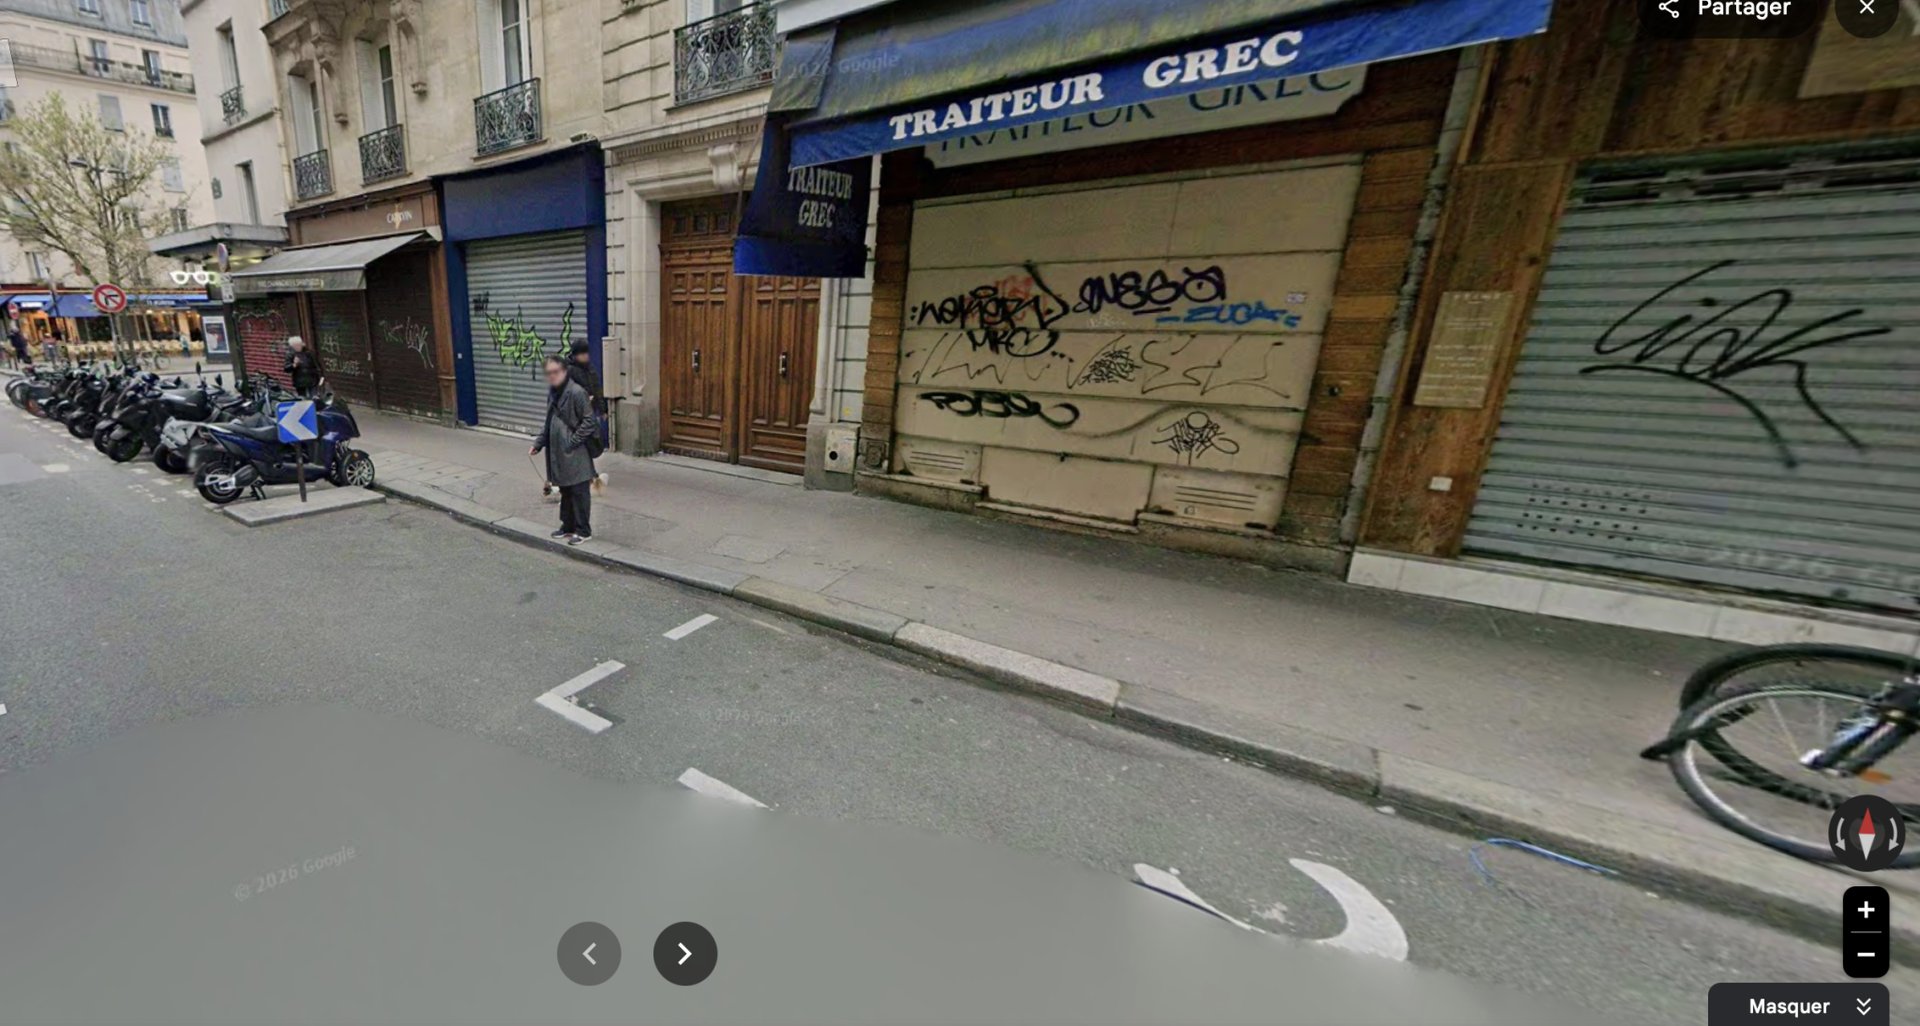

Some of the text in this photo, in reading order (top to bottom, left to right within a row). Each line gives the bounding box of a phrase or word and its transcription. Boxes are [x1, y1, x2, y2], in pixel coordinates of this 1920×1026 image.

[890, 73, 1105, 141] TRAITEUR
[1142, 31, 1303, 88] GREC
[787, 162, 853, 199] TRAITEUR
[798, 199, 836, 228] GREC
